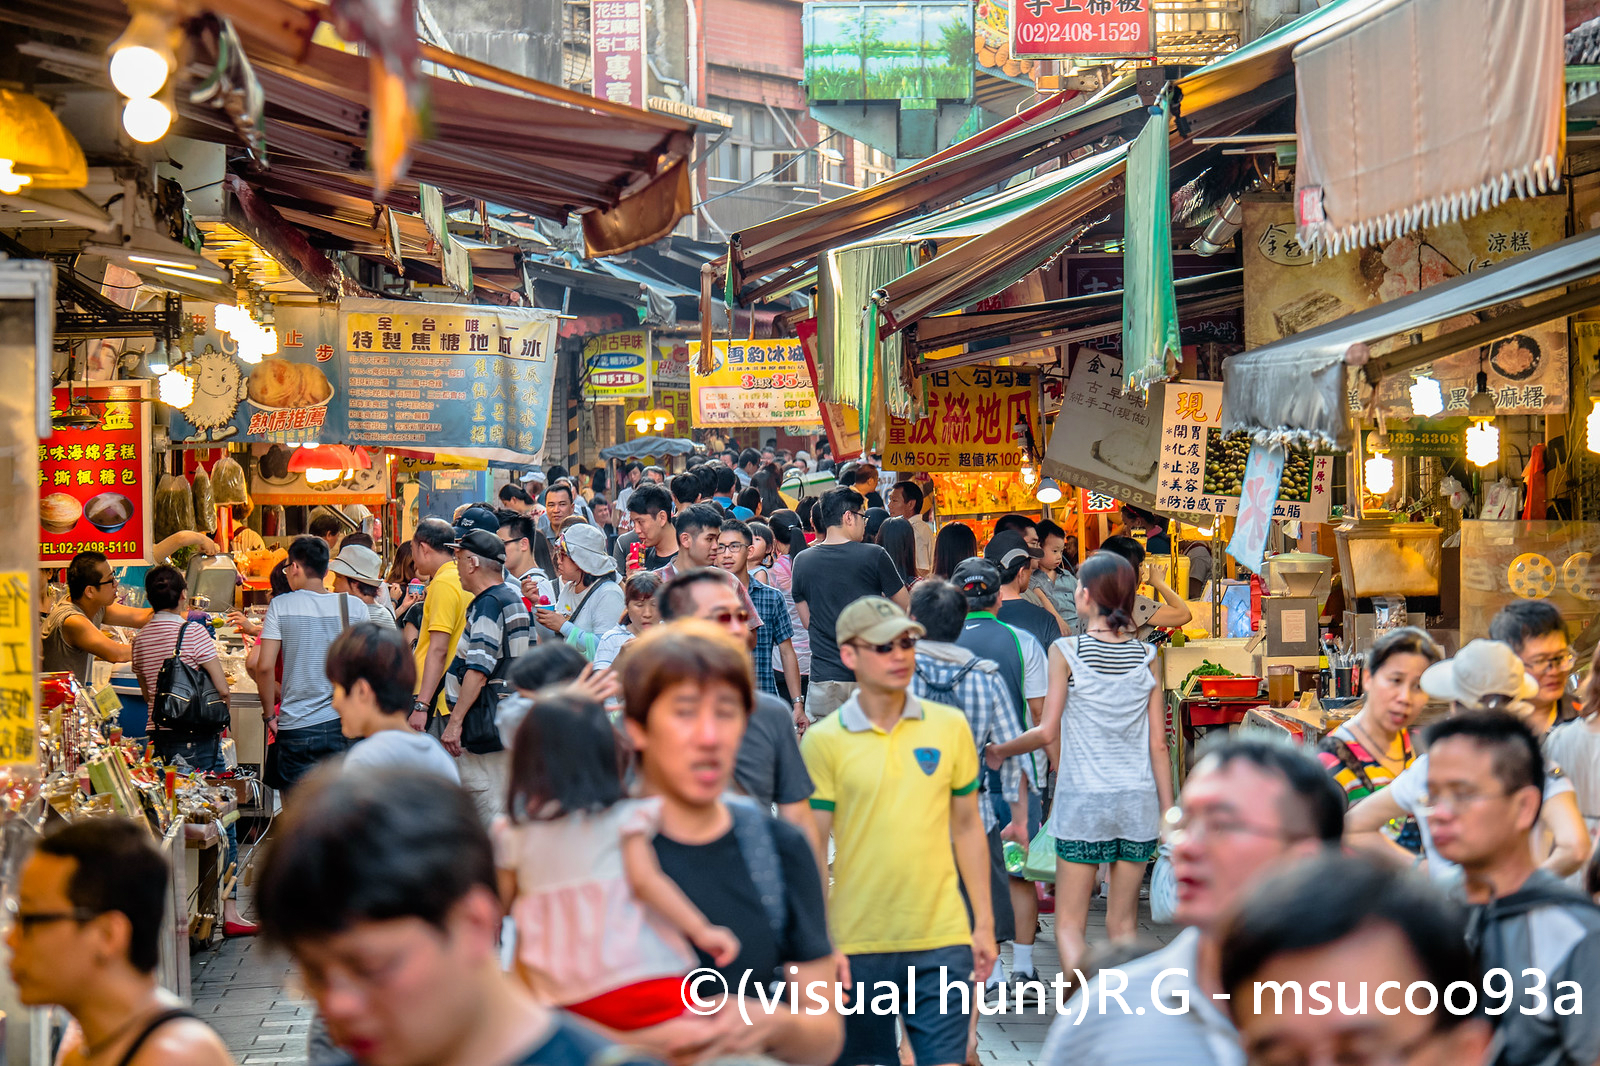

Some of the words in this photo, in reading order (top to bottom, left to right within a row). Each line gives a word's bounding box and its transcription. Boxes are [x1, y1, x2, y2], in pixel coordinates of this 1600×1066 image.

[595, 2, 640, 18] 花生糖
[1017, 22, 1141, 44] (02)2408-1529
[595, 36, 640, 52] 杏仁酥
[605, 54, 631, 106] 專賣
[1487, 231, 1531, 252] 涼糕
[352, 331, 542, 357] 特製焦糖地瓜冰
[608, 334, 643, 350] 古早味
[728, 345, 805, 364] 雪豹冰城
[1448, 386, 1545, 410] 黑麻糬
[1069, 391, 1150, 429] 純手工(現做)
[247, 406, 328, 436] 熱情推薦
[1173, 425, 1202, 440] 開胃
[890, 451, 950, 467] 小份50元
[1170, 461, 1200, 475] 止渴
[1169, 478, 1198, 493] 美容
[1167, 496, 1227, 513] 防治感冒
[38, 541, 136, 554] TEL:02-2498-5110
